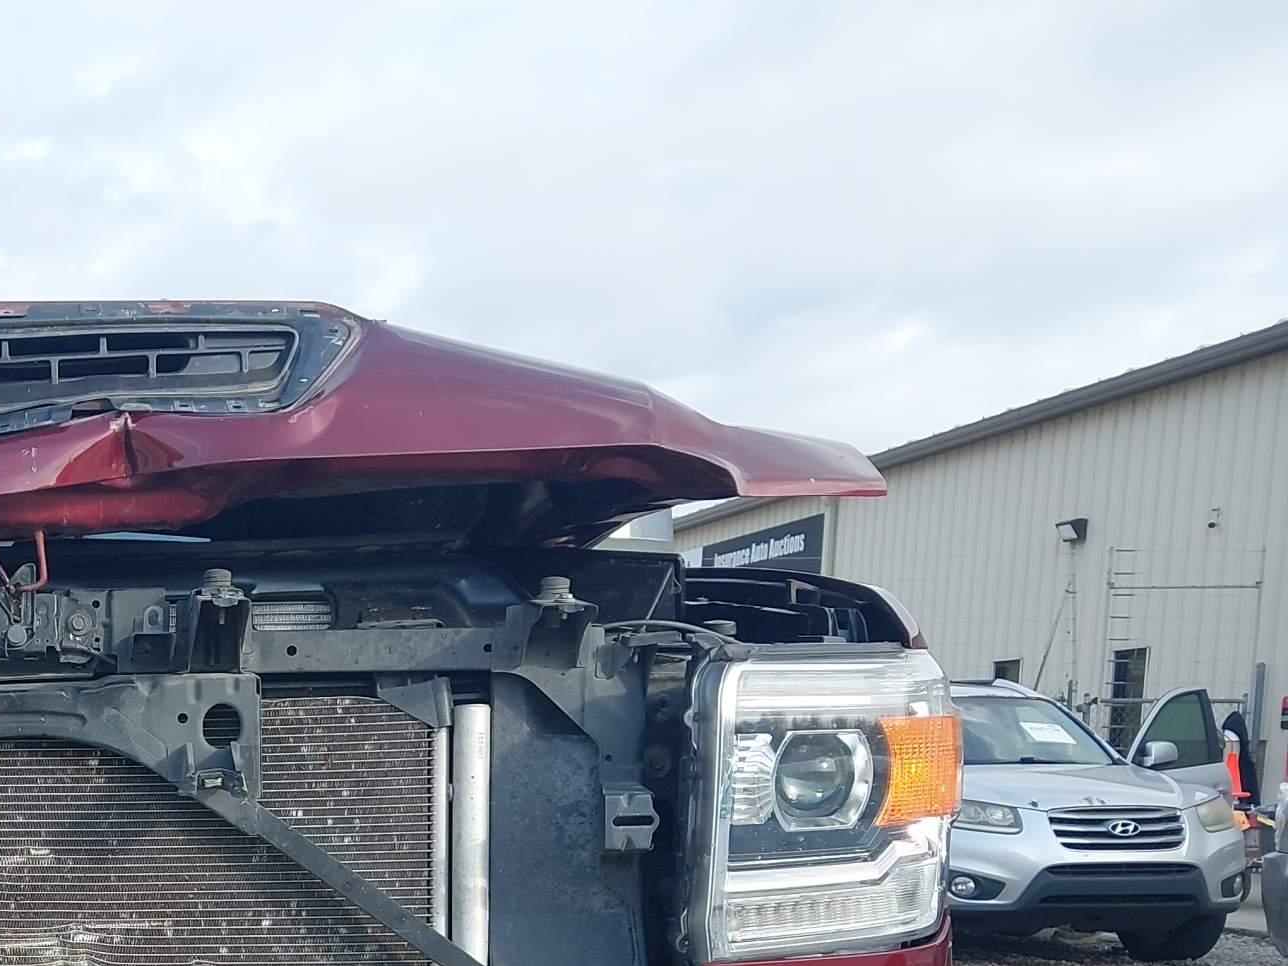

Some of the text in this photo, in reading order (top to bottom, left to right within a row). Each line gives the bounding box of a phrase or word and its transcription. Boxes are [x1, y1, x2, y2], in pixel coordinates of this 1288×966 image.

[714, 533, 805, 568] Insurance Auto Auctions
